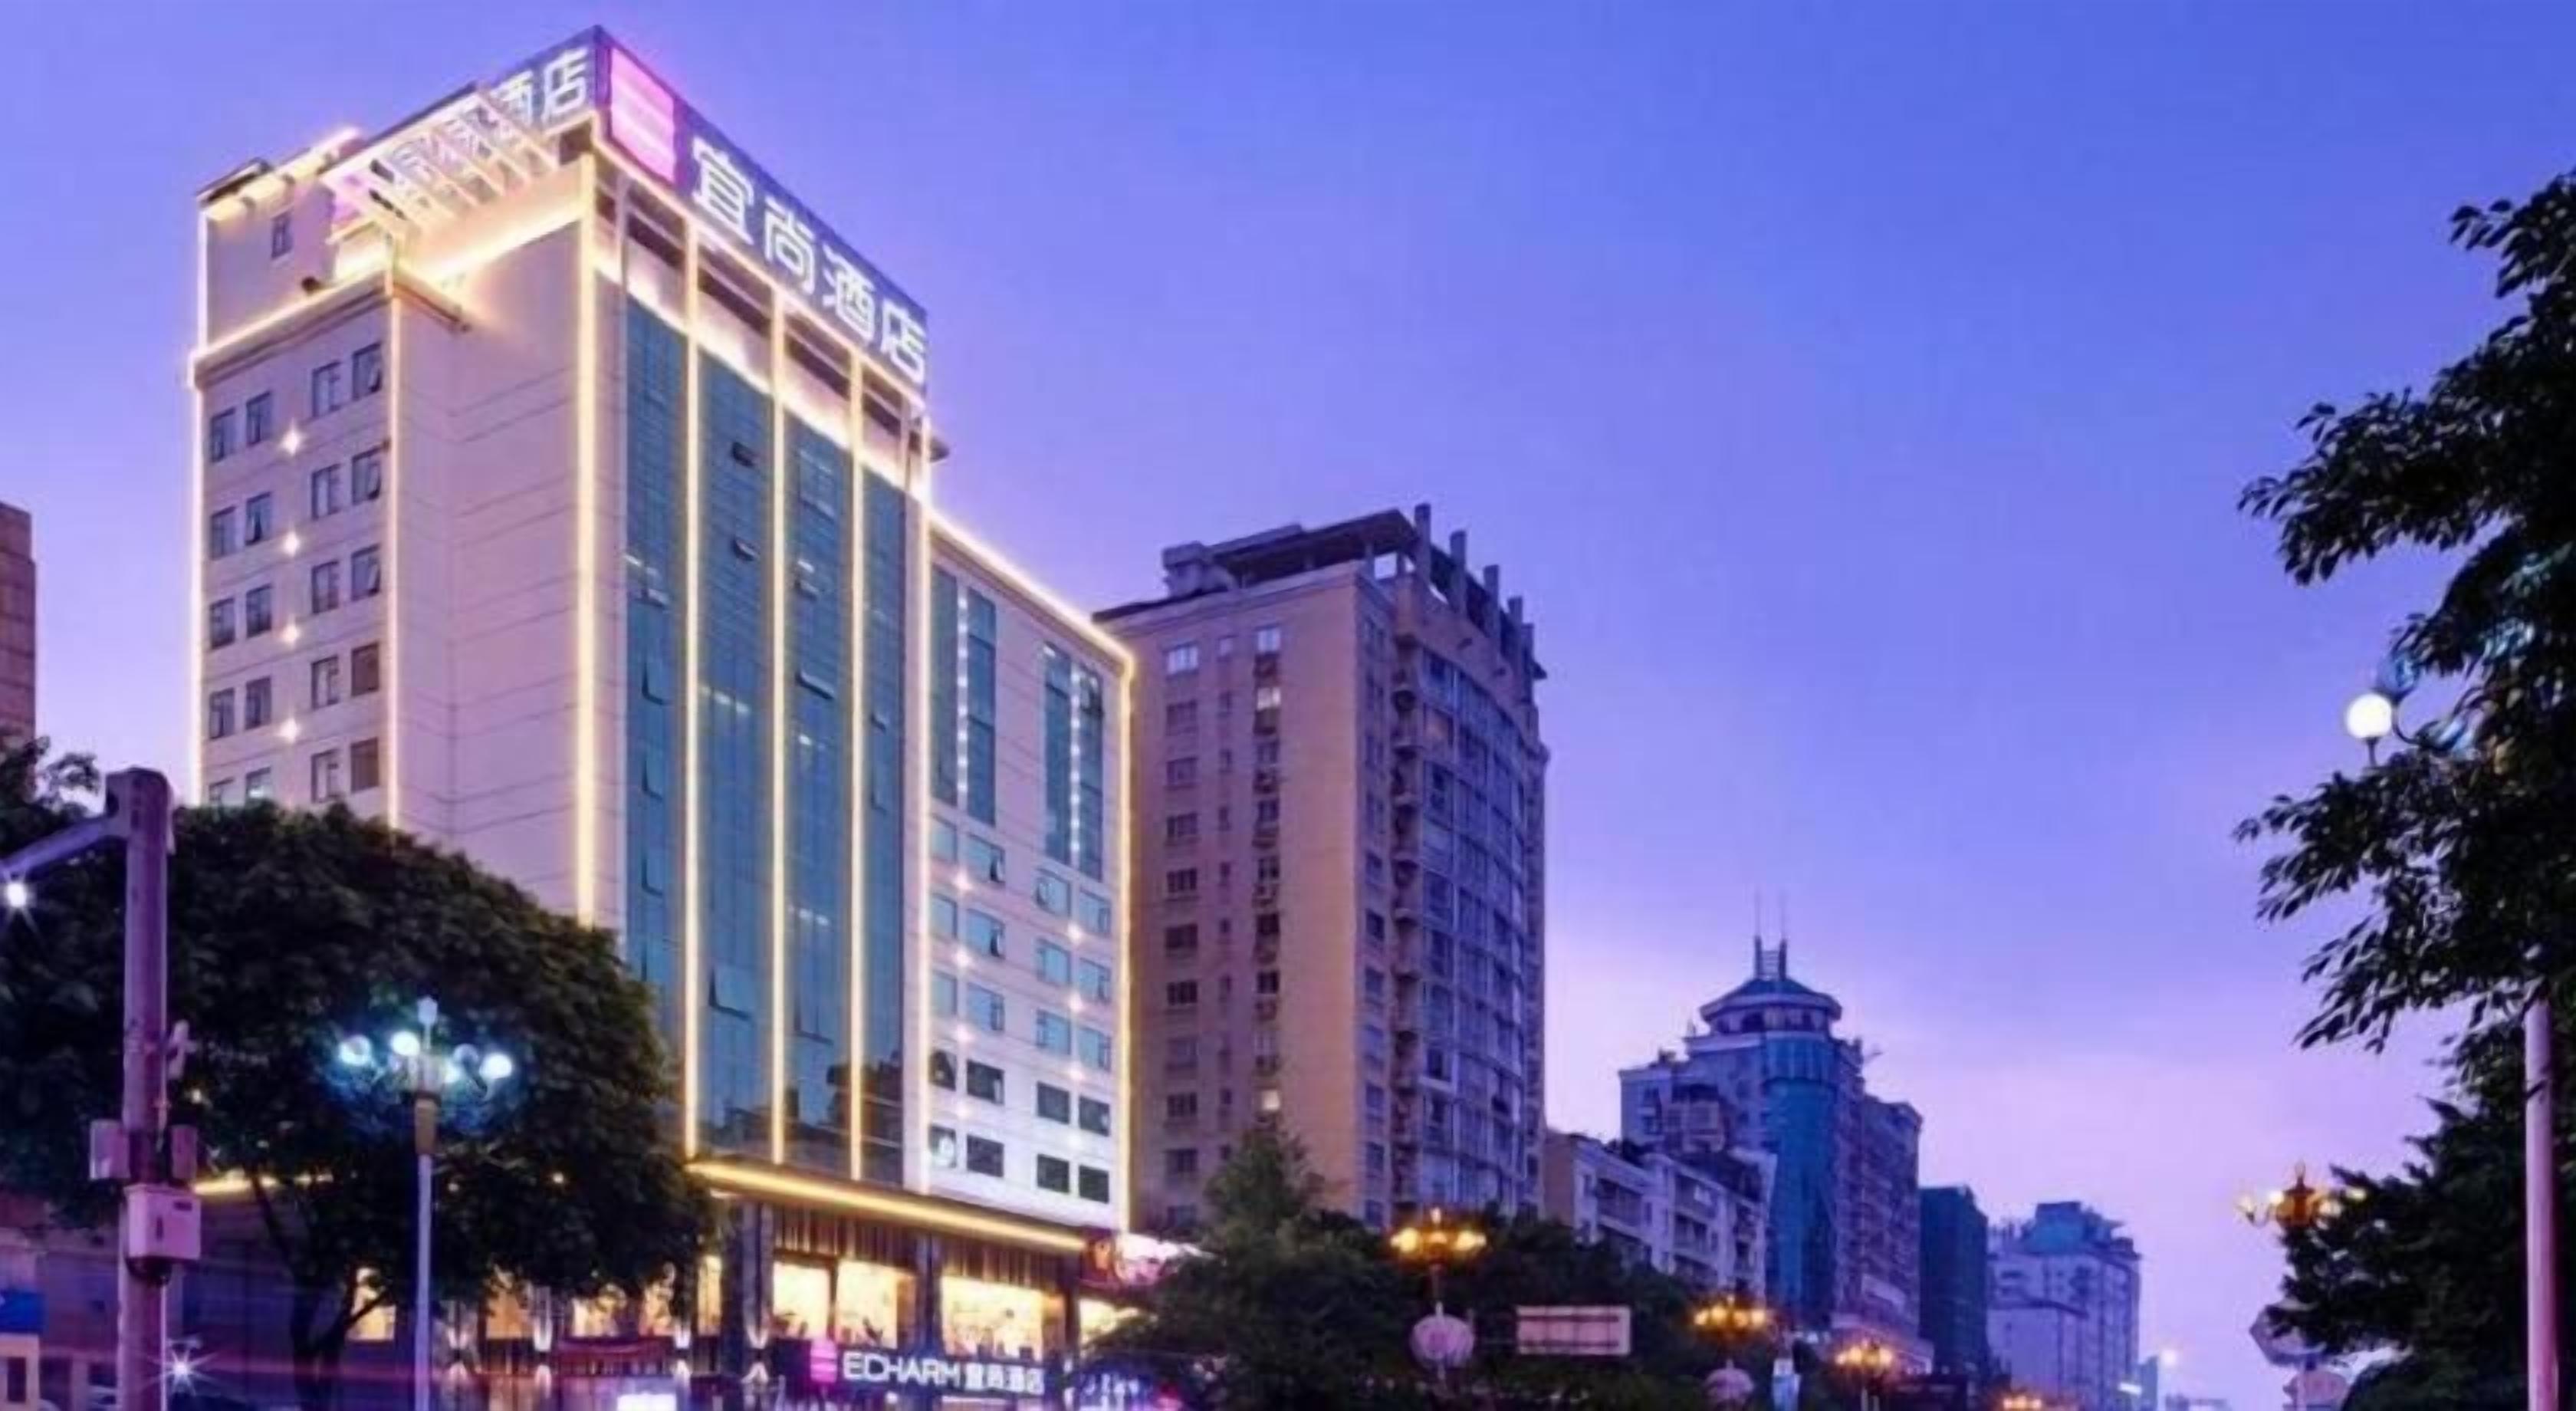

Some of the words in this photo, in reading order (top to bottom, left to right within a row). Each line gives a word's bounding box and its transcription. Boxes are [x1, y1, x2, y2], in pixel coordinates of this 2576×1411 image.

[692, 136, 925, 385] 宜尚酒店
[843, 1350, 959, 1387] ECHARM
